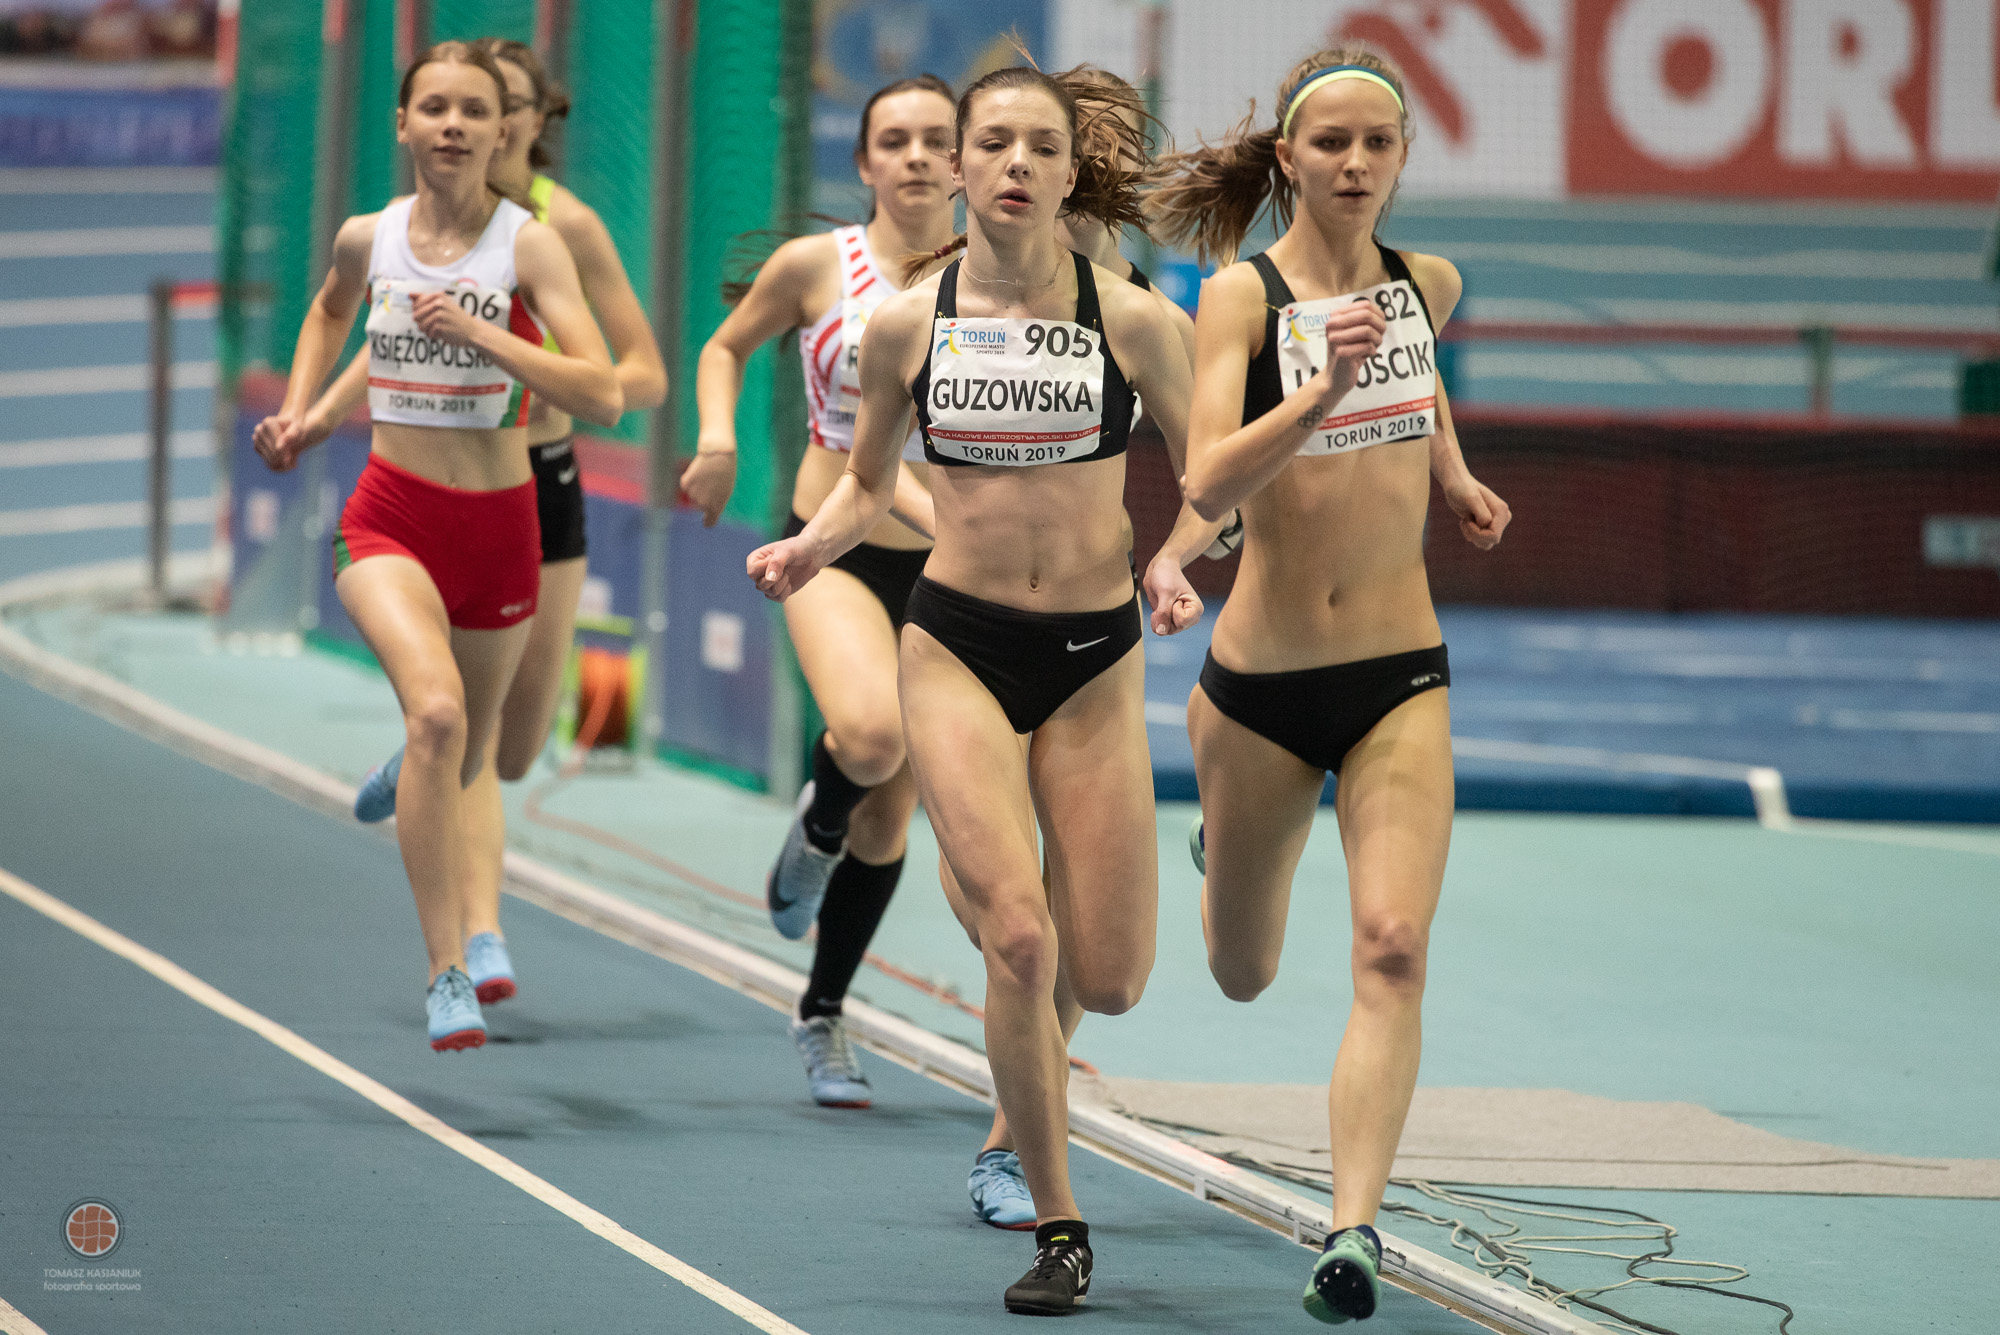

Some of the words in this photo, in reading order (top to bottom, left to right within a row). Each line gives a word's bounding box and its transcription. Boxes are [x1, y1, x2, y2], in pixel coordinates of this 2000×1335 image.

[444, 290, 499, 320] 06
[1352, 287, 1417, 322] 82
[961, 328, 1006, 343] TORUŃ
[1024, 323, 1094, 359] 905
[932, 378, 1094, 412] GUZOWSKA
[1325, 420, 1382, 449] TORUŃ
[1388, 416, 1427, 437] 2019
[961, 444, 1019, 462] TORUŃ
[1025, 446, 1066, 462] 2019
